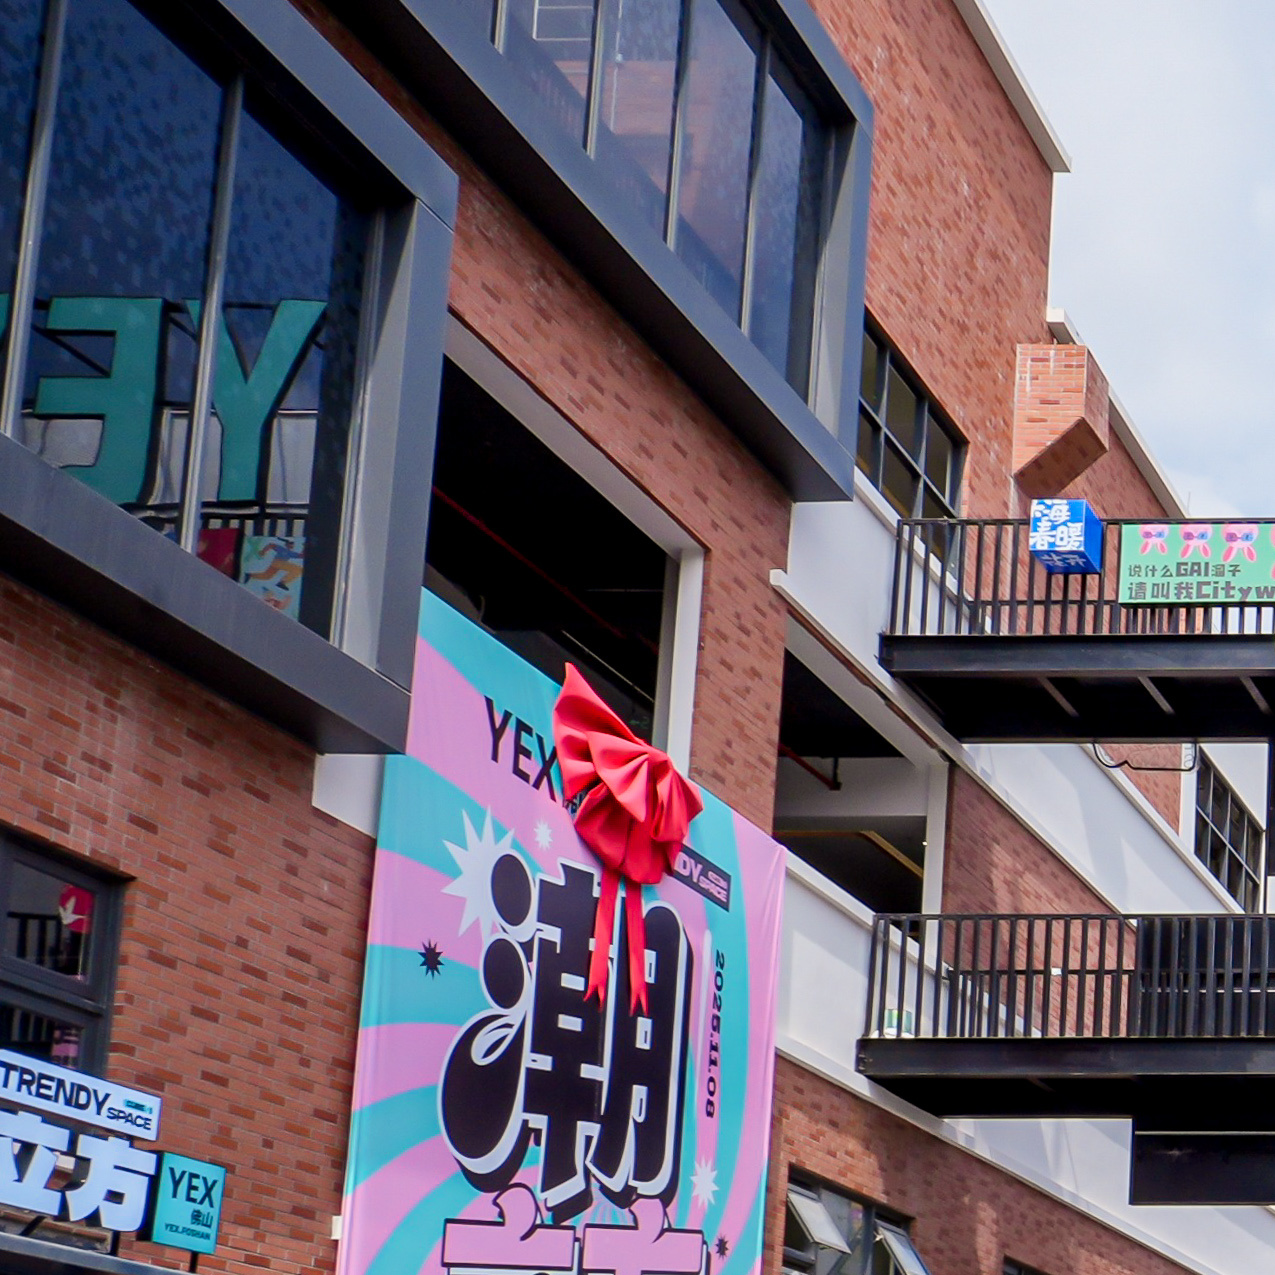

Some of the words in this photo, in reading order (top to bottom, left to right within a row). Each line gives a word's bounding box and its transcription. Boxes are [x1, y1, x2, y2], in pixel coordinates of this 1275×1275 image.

[484, 696, 558, 802] YEX
[440, 852, 690, 1210] 潮
[704, 948, 726, 1120] 2025.11.08
[0, 1060, 111, 1116] TRENDY
[107, 1106, 152, 1131] SPACE
[169, 1167, 220, 1208] YEX
